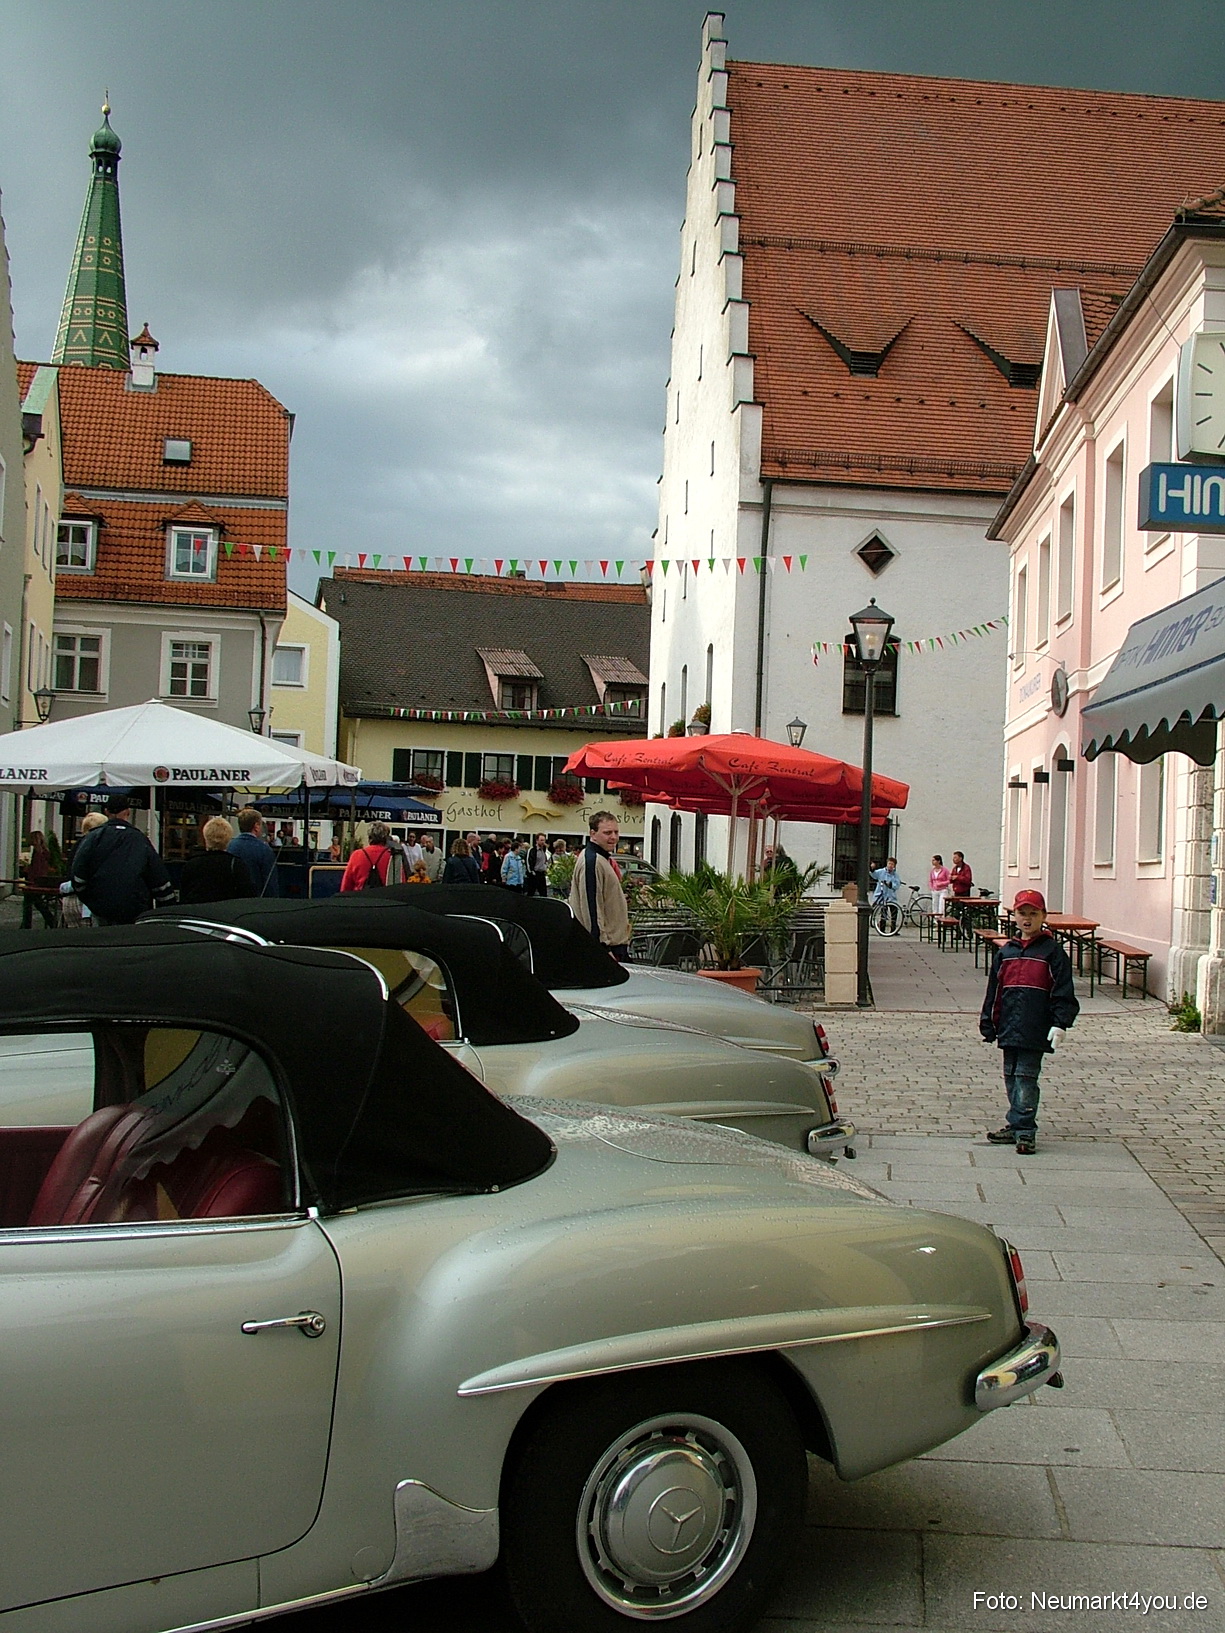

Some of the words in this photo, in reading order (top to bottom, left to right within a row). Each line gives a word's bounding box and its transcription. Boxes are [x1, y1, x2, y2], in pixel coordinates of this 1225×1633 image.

[631, 752, 674, 765] Zentral
[171, 768, 250, 781] PAULANER
[767, 761, 815, 777] Zentral
[338, 808, 392, 820] PALANER
[407, 811, 439, 822] PAULANER
[446, 801, 503, 822] Gasthof
